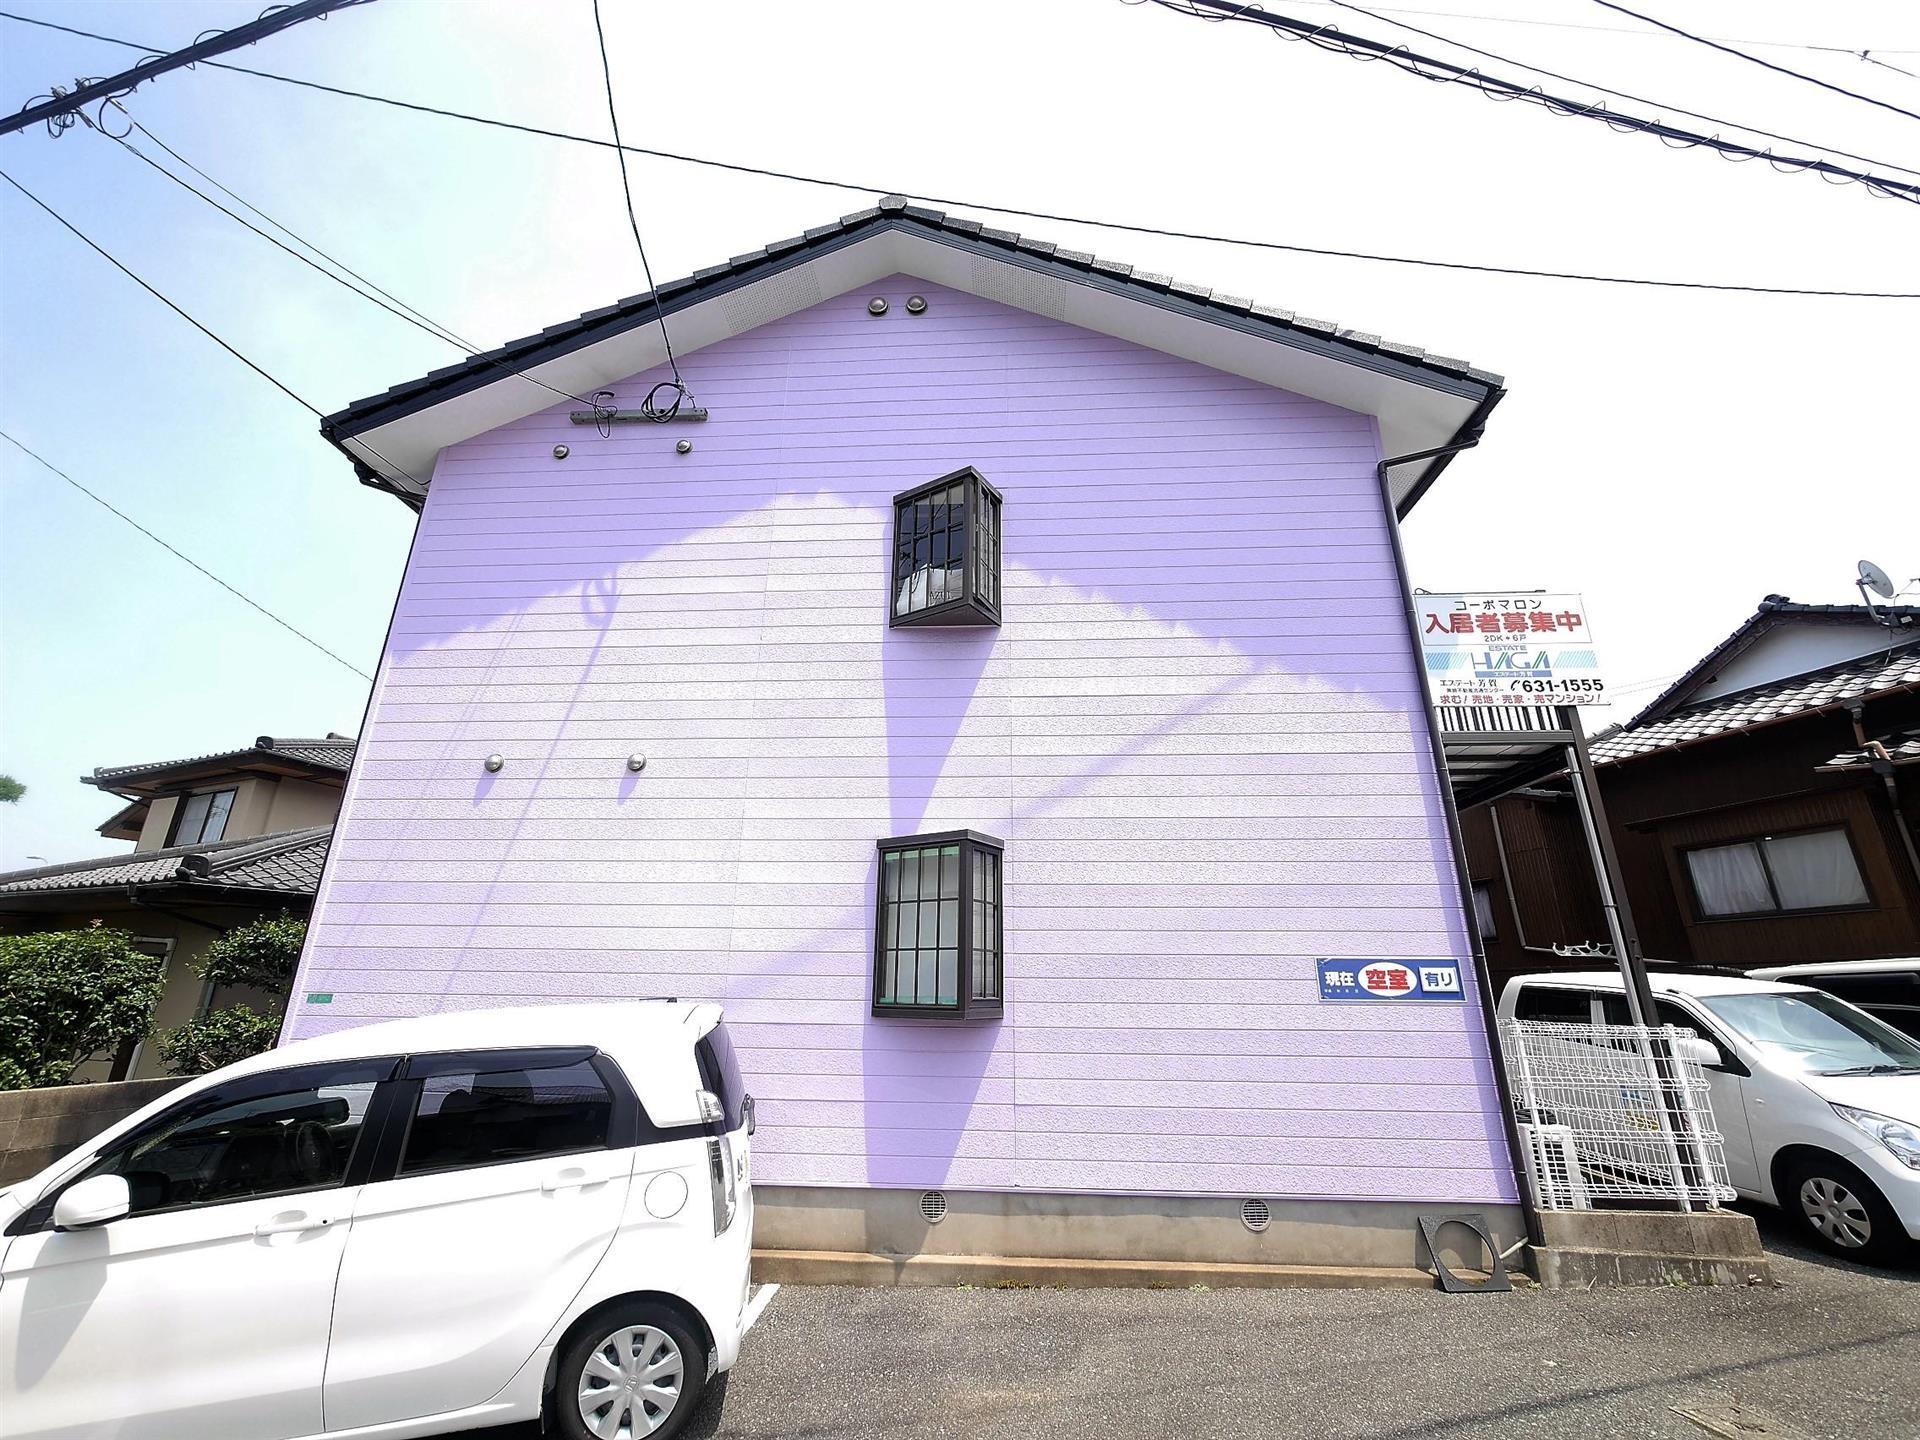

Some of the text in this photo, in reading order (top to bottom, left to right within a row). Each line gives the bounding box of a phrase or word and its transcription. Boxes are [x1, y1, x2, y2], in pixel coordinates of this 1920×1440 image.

[1454, 599, 1542, 611] コーポマロン
[1425, 611, 1582, 634] 入居者募集中
[1470, 651, 1551, 670] HAGA
[1523, 679, 1604, 693] 631-1555
[1325, 971, 1355, 987] 現在
[1365, 968, 1410, 990] 空室
